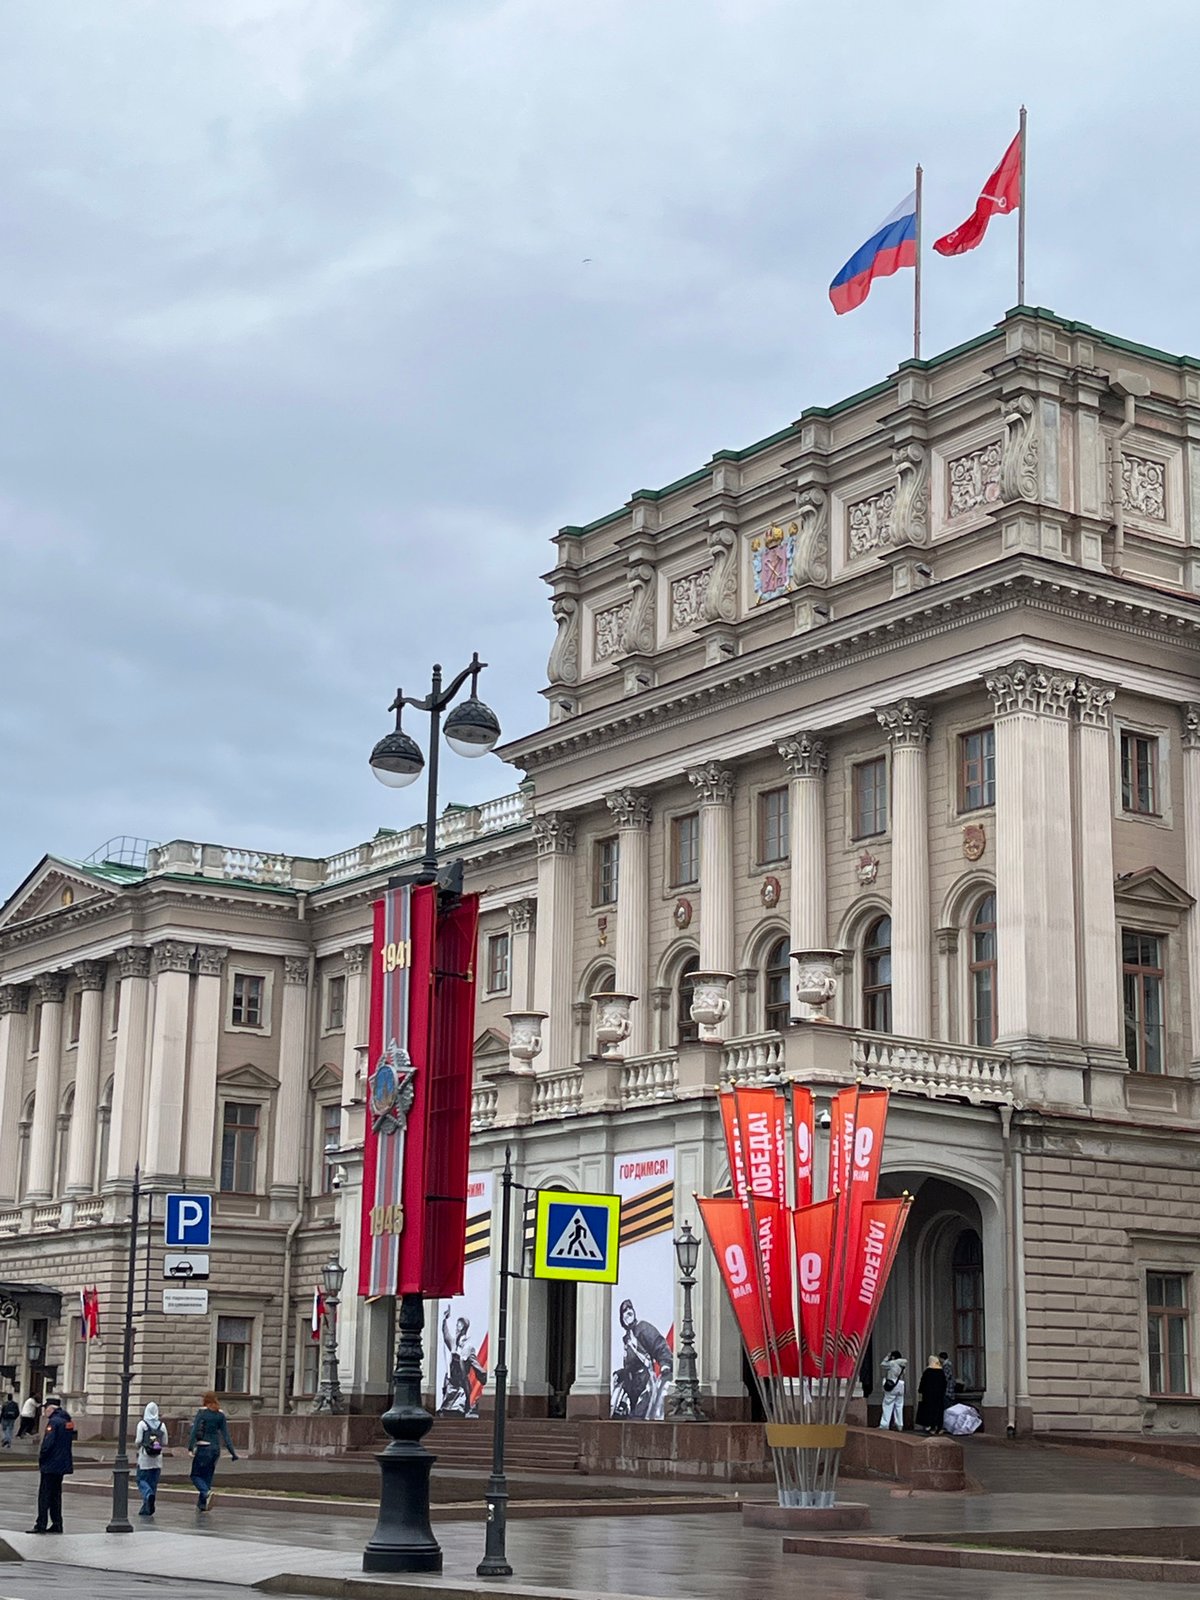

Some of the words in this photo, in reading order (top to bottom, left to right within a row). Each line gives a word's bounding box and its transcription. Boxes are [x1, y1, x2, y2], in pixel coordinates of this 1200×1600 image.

[380, 938, 412, 974] 1941
[798, 1122, 809, 1163] 9
[619, 1158, 669, 1180] ГОРДИМСЯ!
[178, 1200, 203, 1240] P
[369, 1203, 404, 1236] 1945
[725, 1243, 748, 1284] 9
